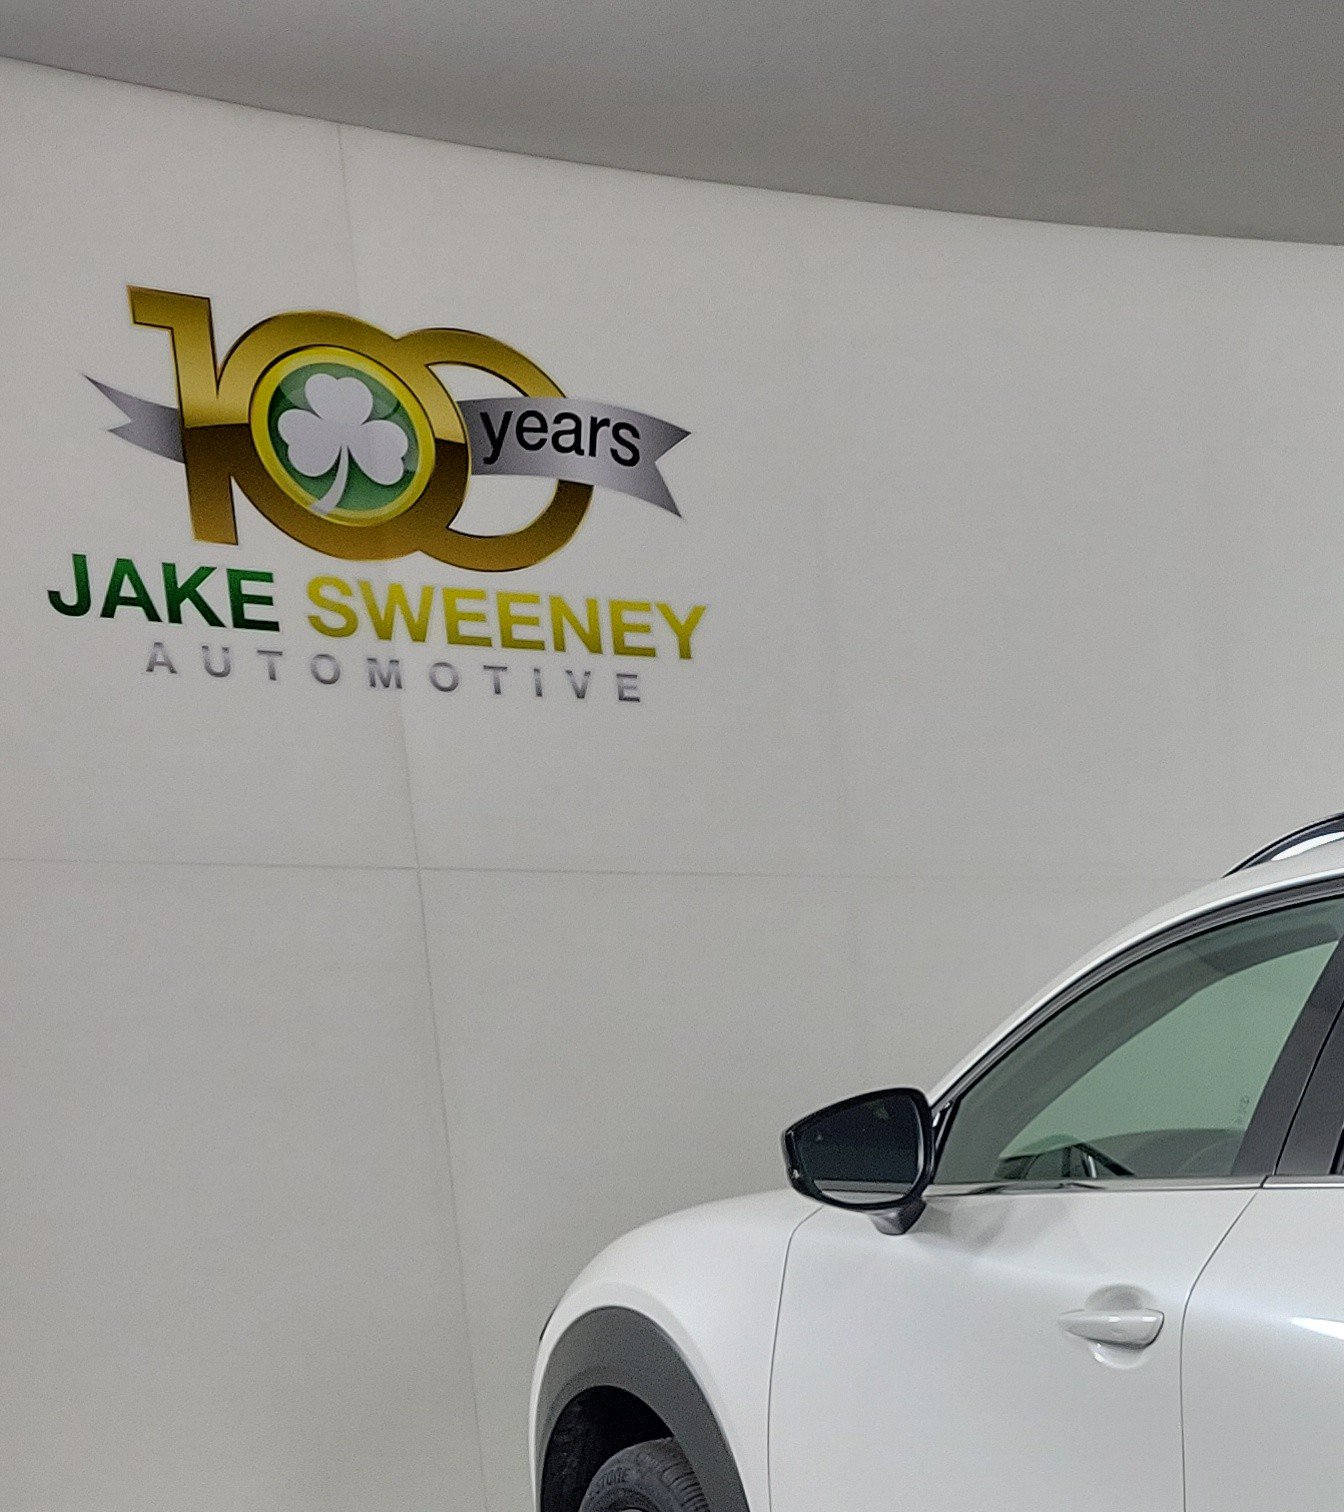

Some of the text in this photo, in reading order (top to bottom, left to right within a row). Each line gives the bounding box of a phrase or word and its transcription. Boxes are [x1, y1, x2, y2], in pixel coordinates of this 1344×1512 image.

[126, 284, 643, 573] 100 years
[47, 553, 708, 661] JAKE SWEENEY
[146, 641, 642, 703] AUTOMOTIVE
